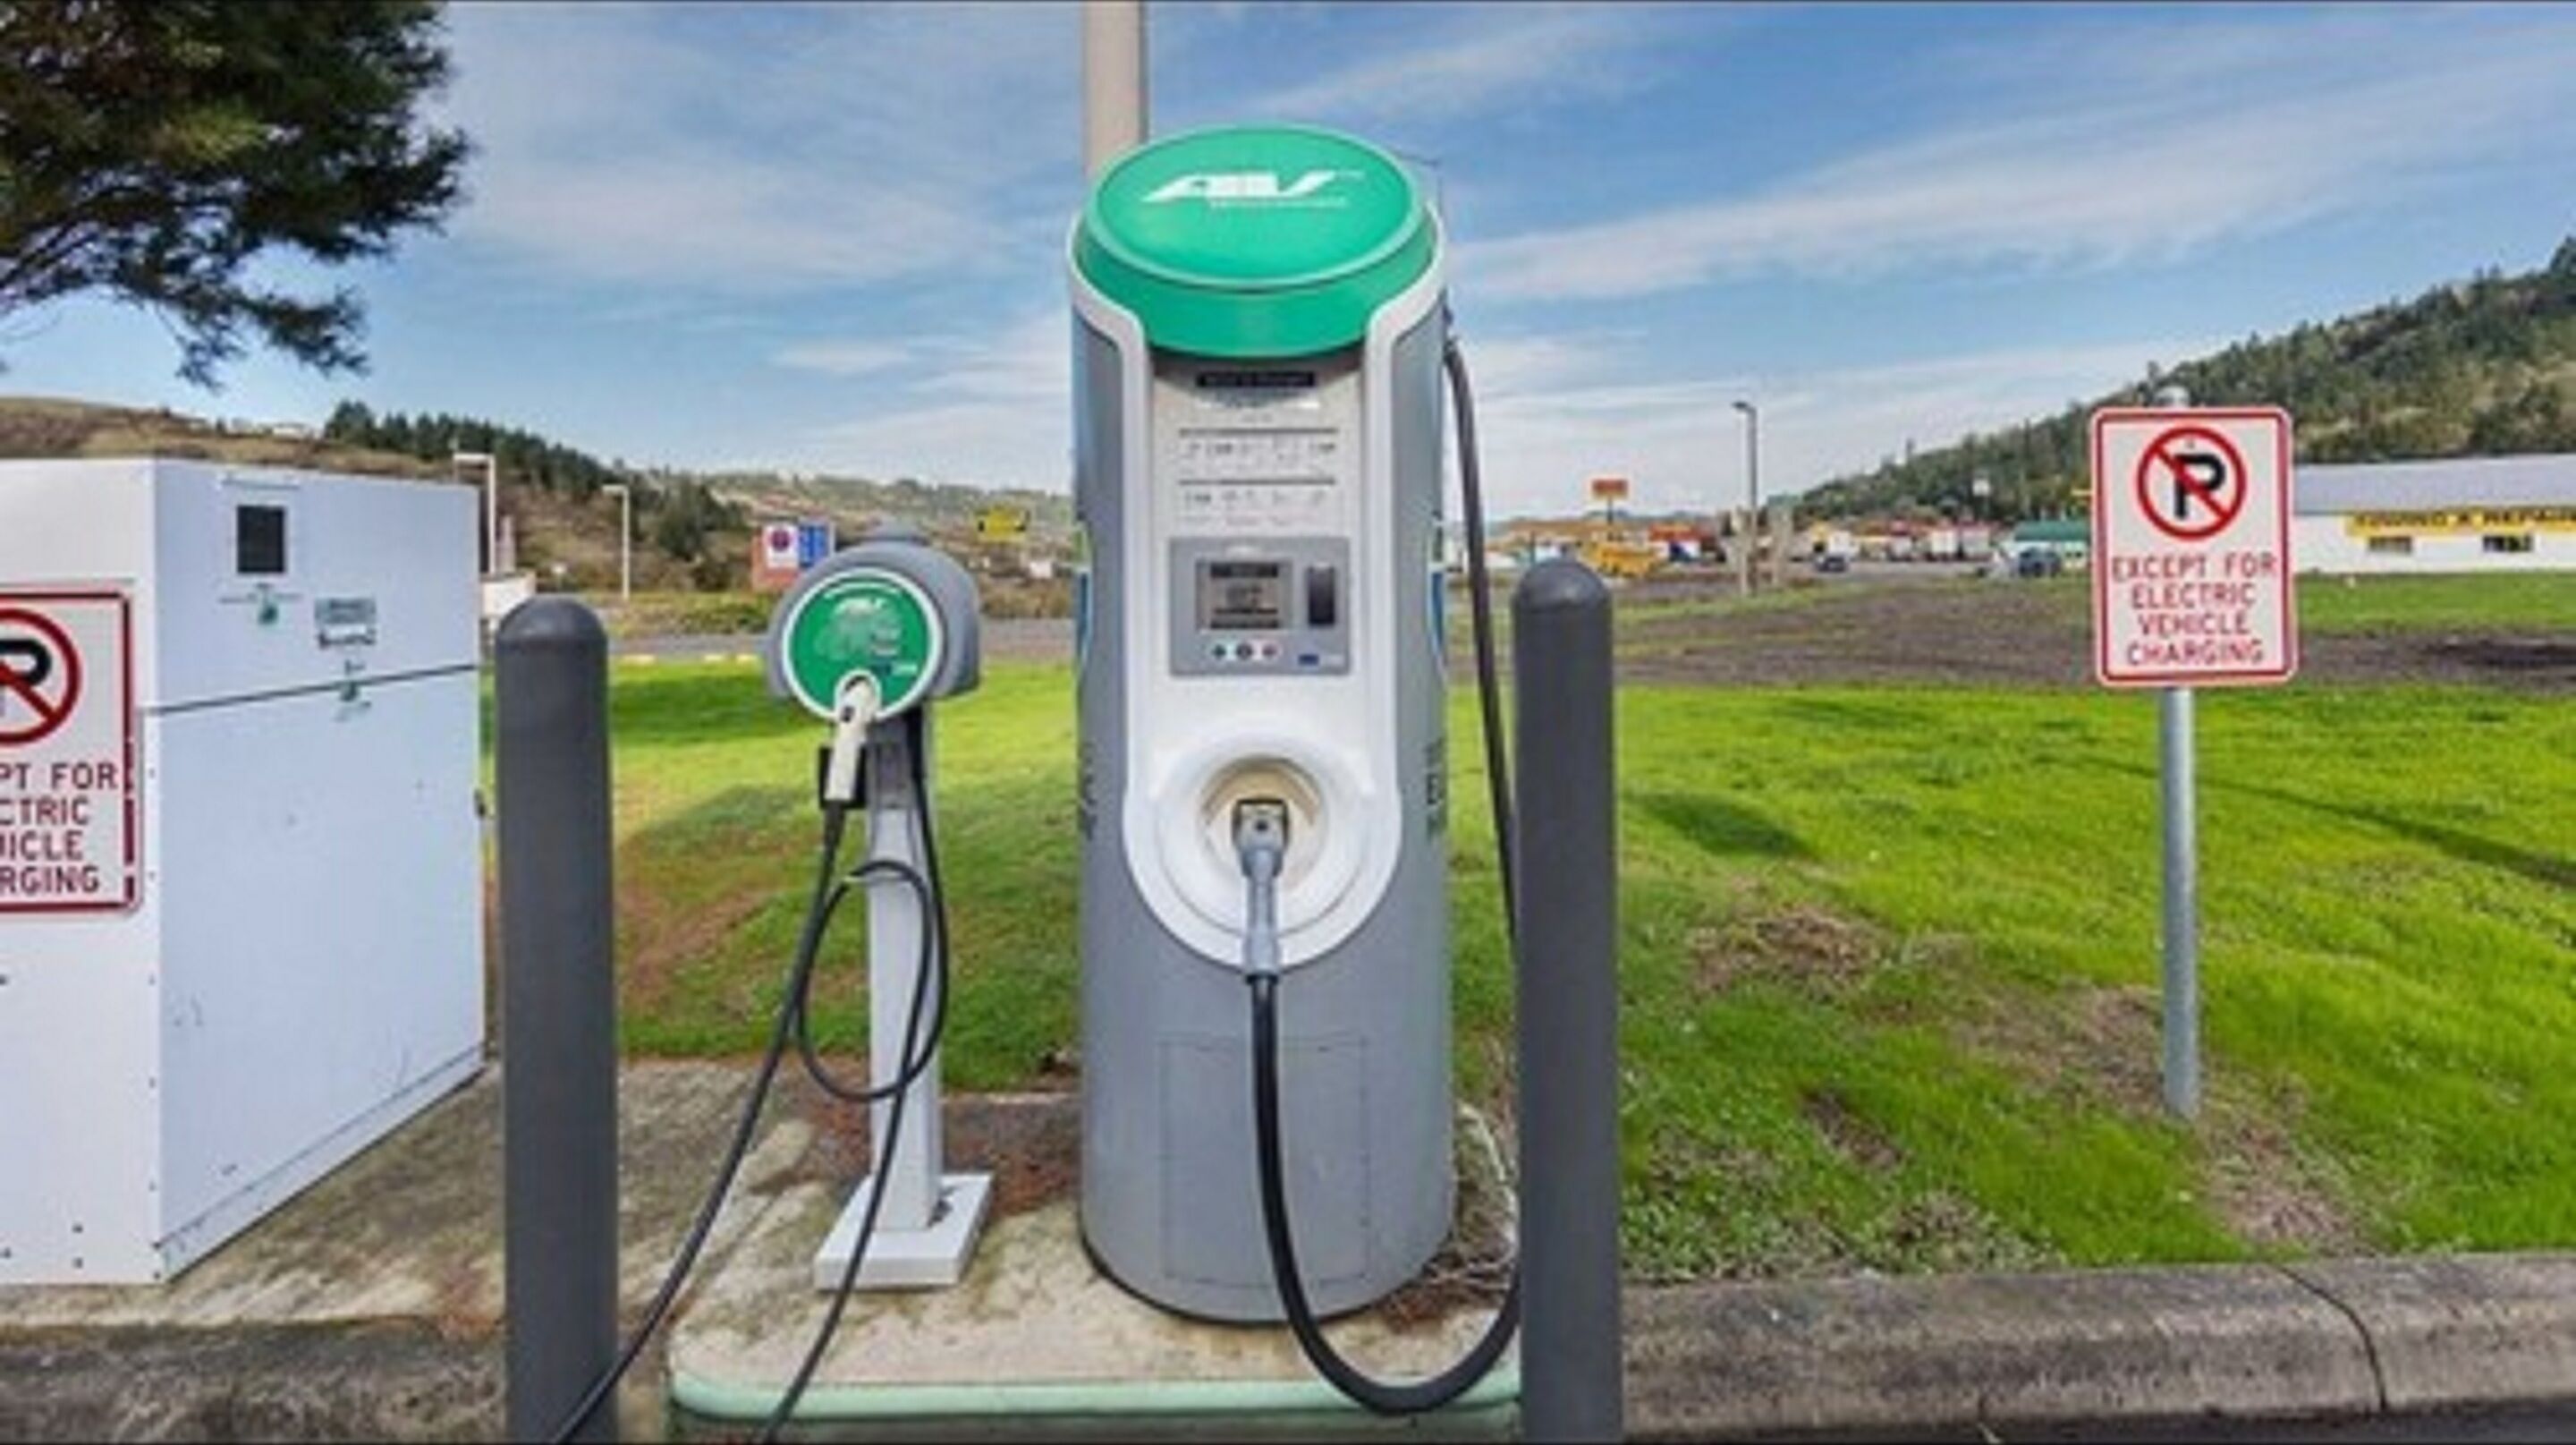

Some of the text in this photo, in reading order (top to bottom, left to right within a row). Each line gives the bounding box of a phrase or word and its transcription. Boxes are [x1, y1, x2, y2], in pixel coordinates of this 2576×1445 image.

[2113, 552, 2276, 581] EXCEPT FOR
[2131, 582, 2256, 609] ELECTRIC
[2138, 612, 2250, 636] VEHICLE
[2127, 638, 2263, 666] CHARGING
[51, 762, 118, 789] FOR
